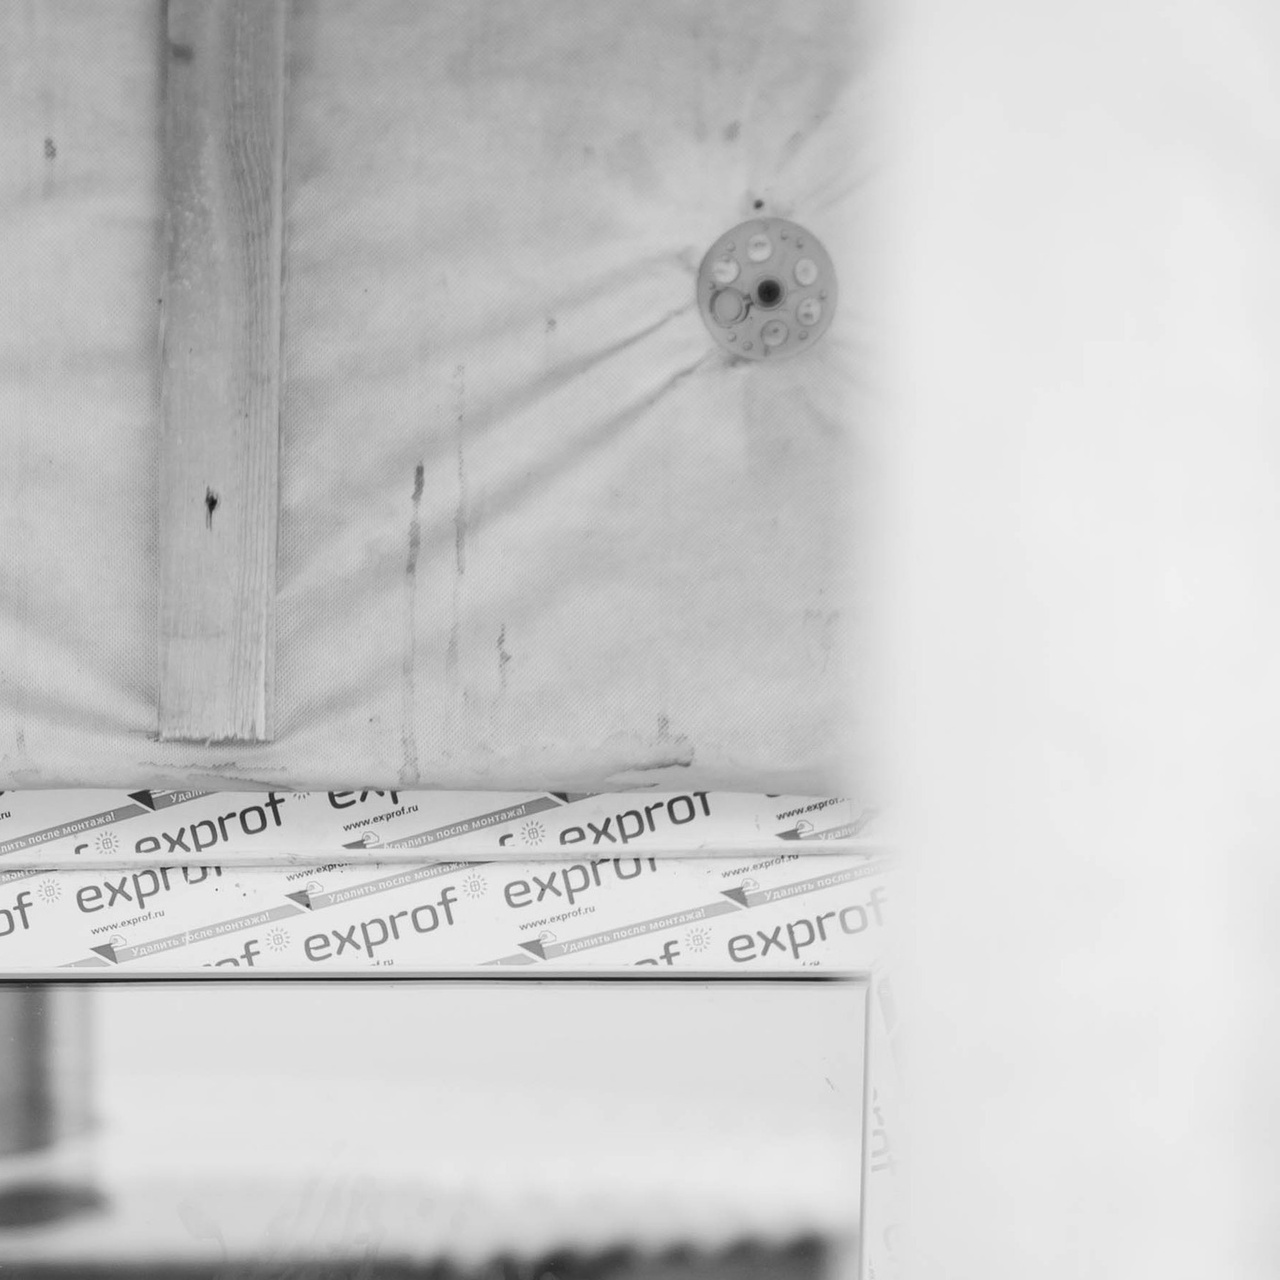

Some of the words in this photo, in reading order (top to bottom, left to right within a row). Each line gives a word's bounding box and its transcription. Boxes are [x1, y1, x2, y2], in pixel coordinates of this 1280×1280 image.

[28, 827, 62, 845] после
[62, 811, 116, 836] монтажа!
[134, 790, 286, 854] exprof
[342, 803, 419, 832] www.exprof.ru
[435, 820, 470, 840] после
[471, 803, 527, 831] монтажа!
[763, 879, 814, 901] Удалить
[815, 868, 852, 889] после
[89, 909, 166, 937] www.exprof.ru
[130, 936, 179, 958] Удалить
[180, 927, 214, 946] после
[215, 911, 270, 938] монтажа!
[303, 885, 458, 963] exprof
[518, 904, 597, 932] www.exprof.ru
[560, 932, 610, 955] Удалить
[612, 922, 647, 942] после
[648, 907, 706, 933] монтажа!
[727, 885, 888, 964] exprof
